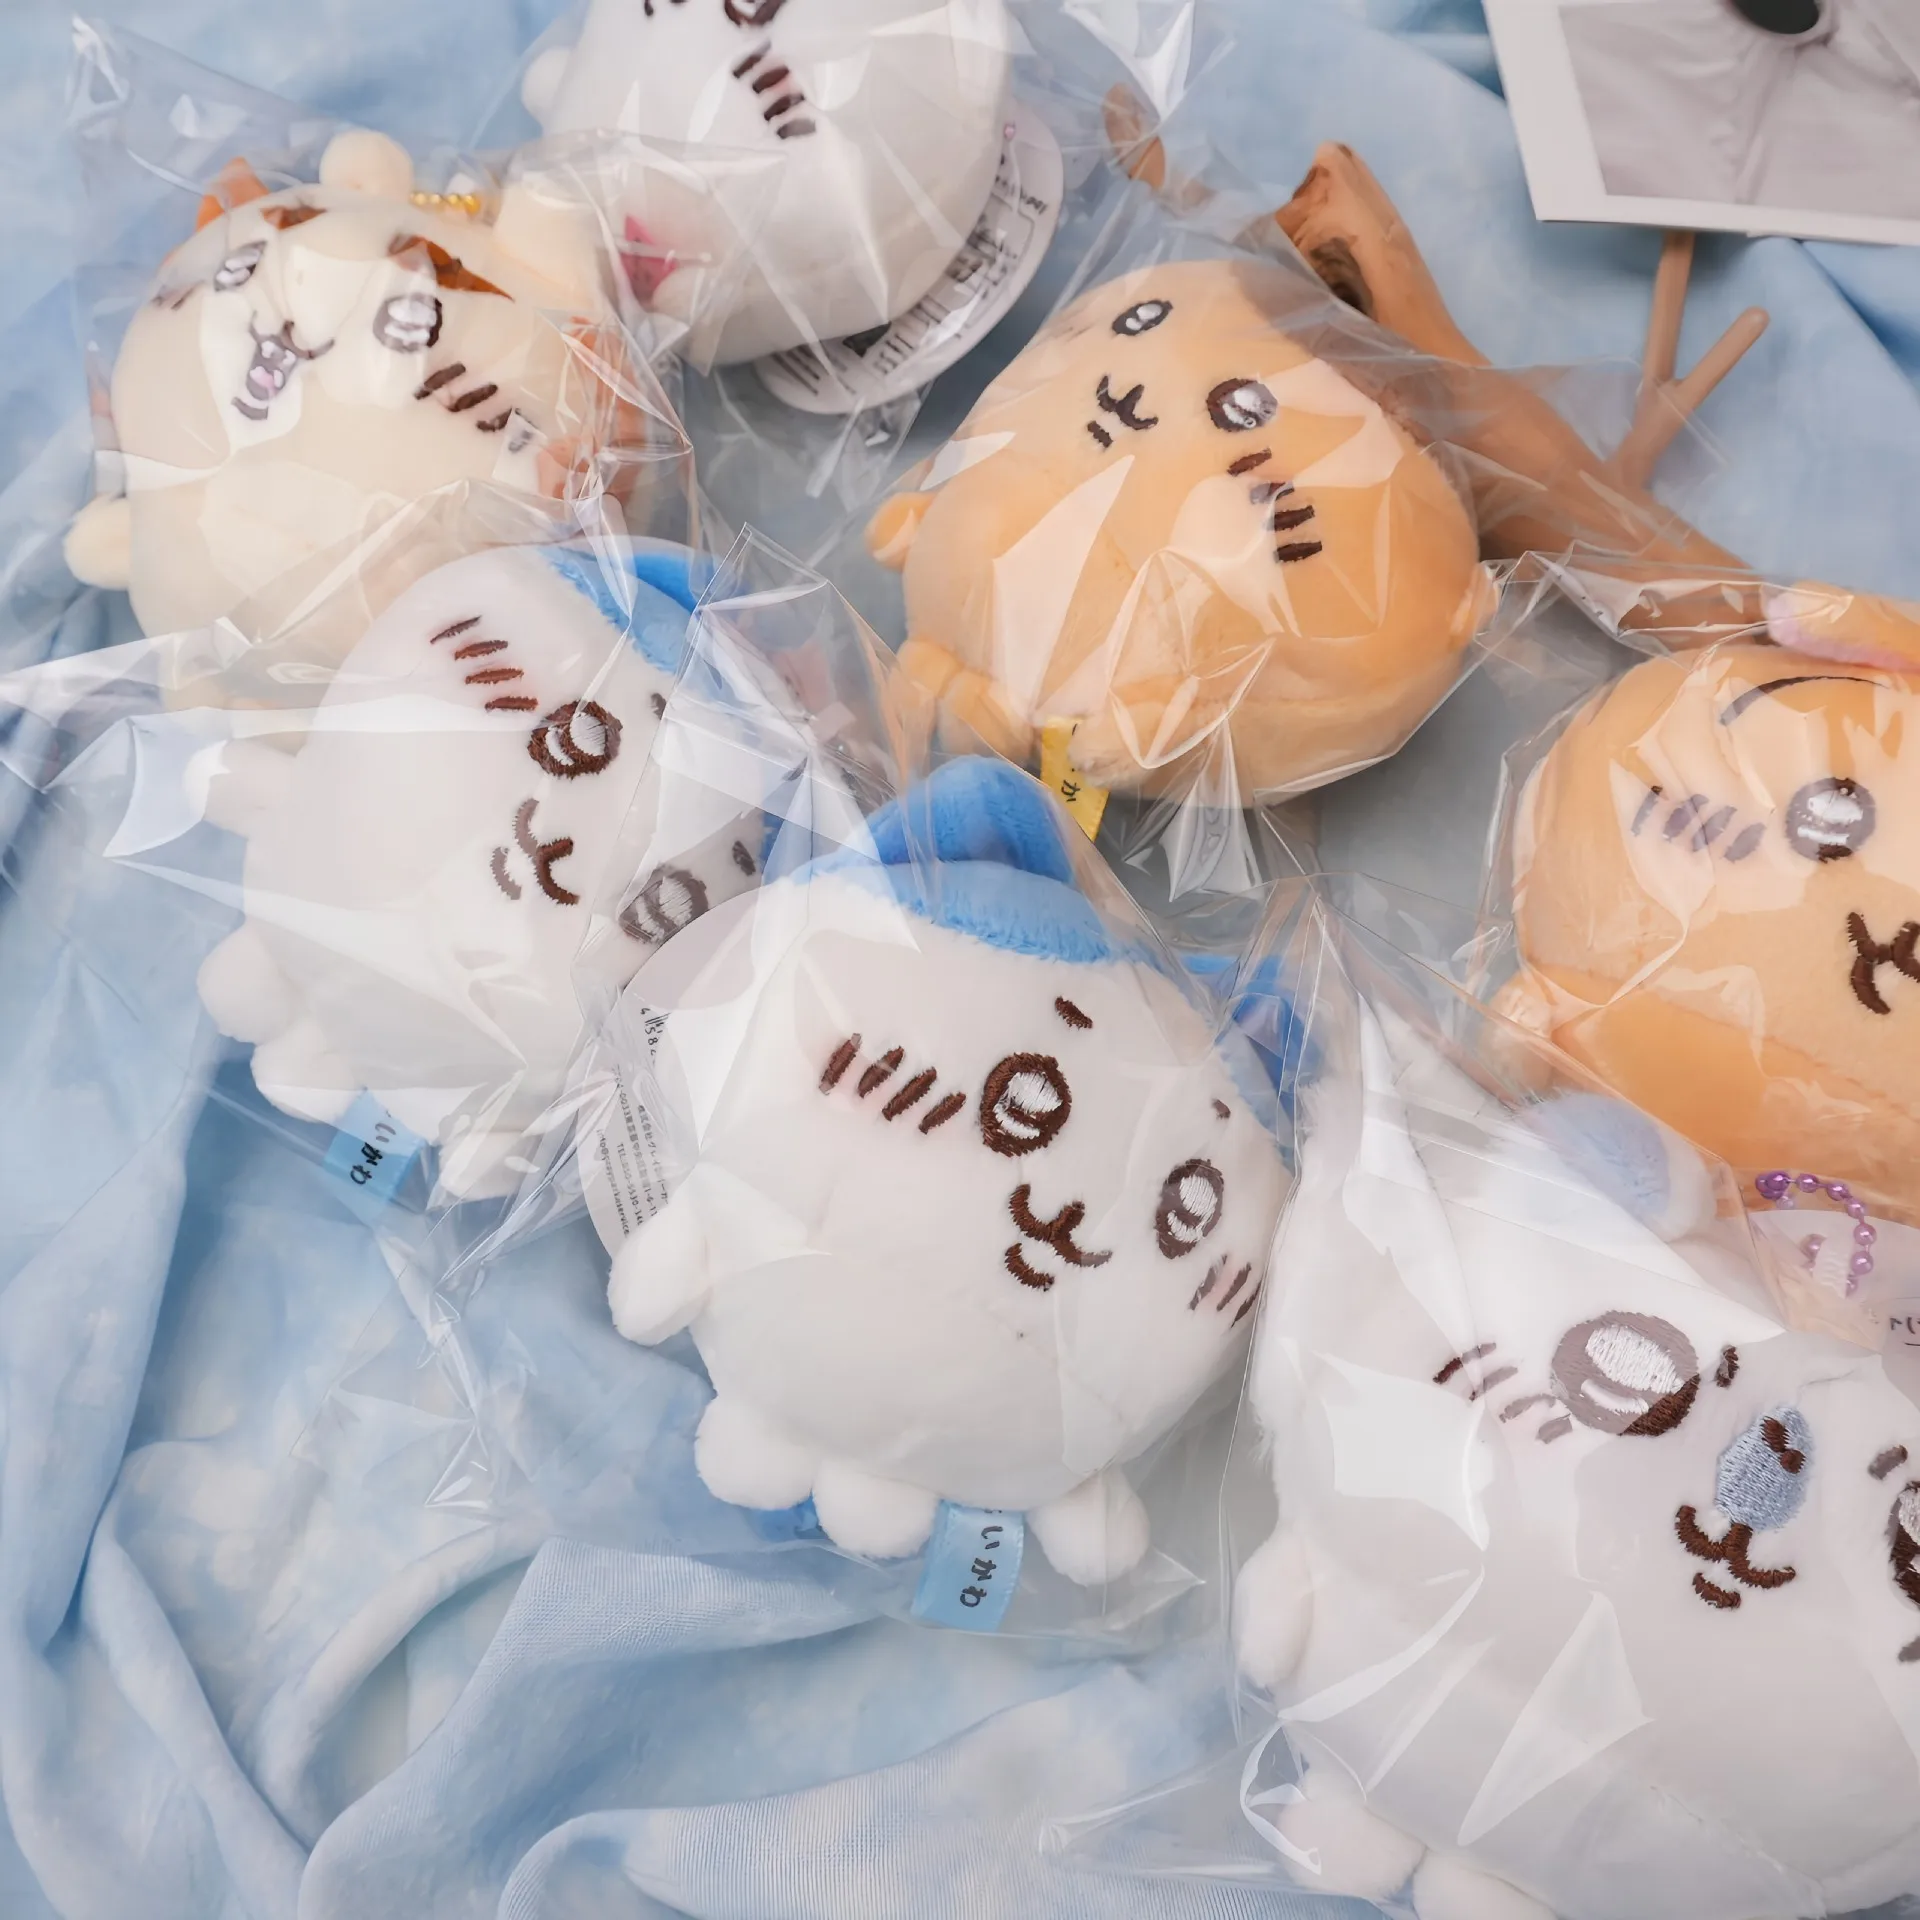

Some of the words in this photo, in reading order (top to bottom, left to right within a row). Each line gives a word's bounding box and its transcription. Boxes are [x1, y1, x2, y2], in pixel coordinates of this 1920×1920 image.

[350, 1111, 397, 1185] いかわ
[959, 1510, 1004, 1608] いかわ
